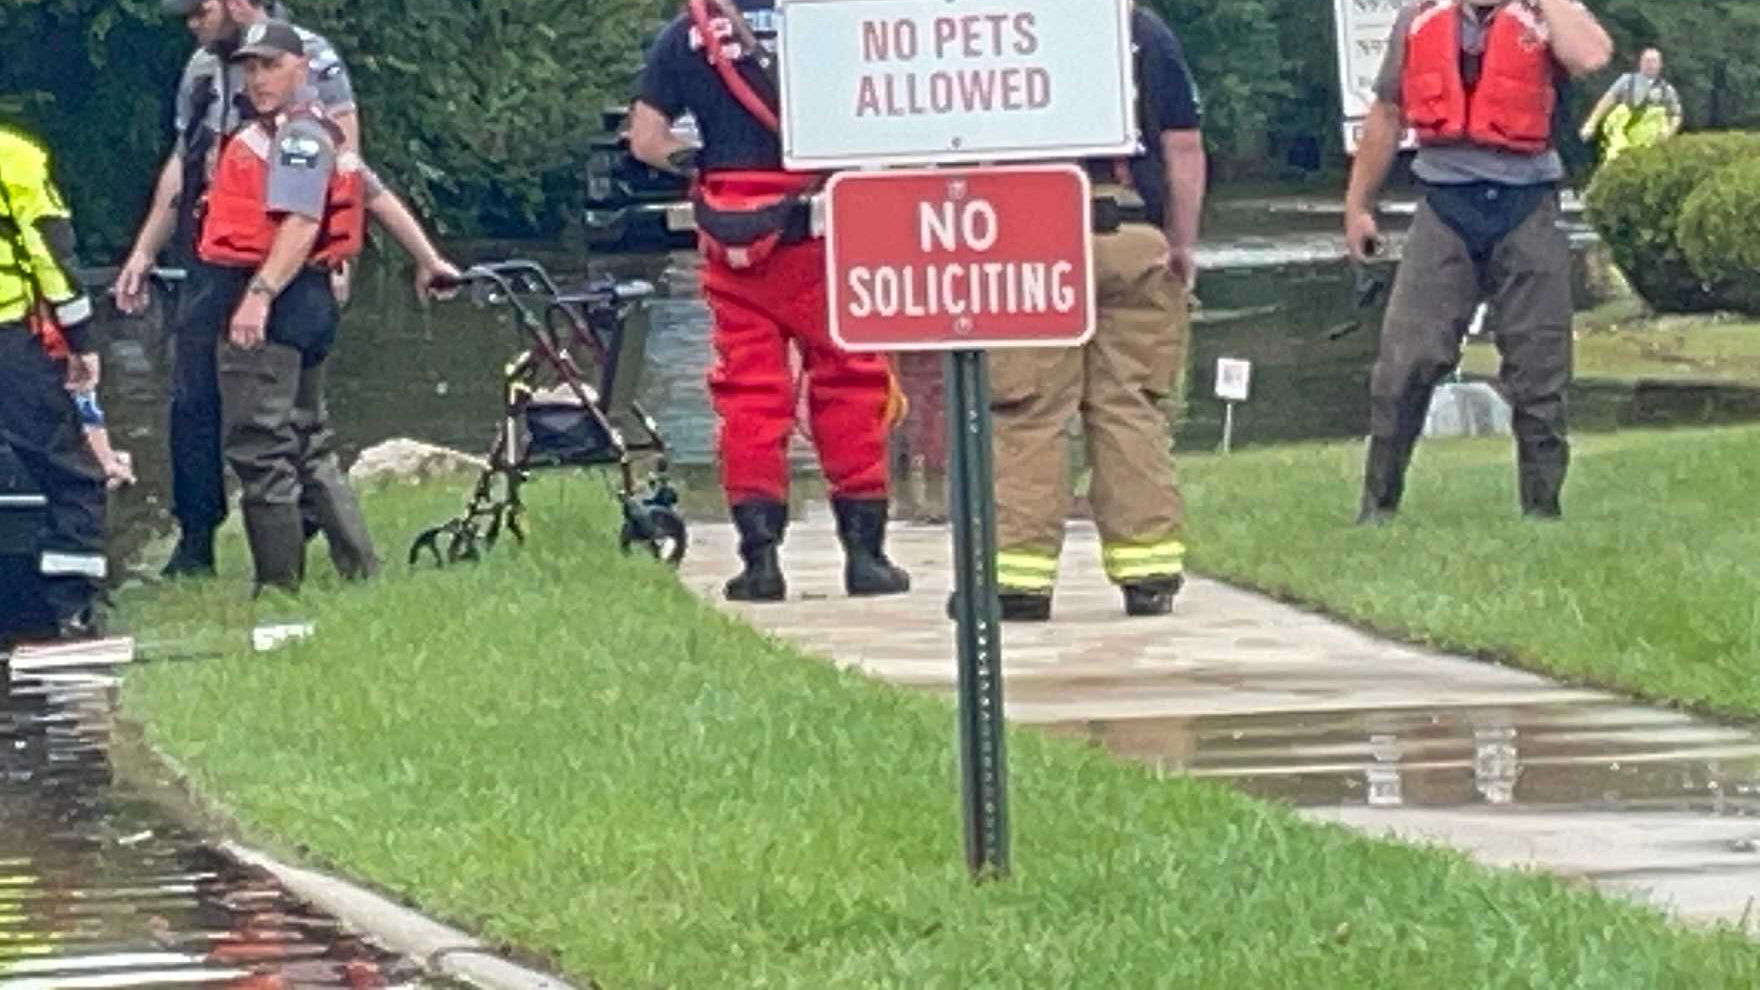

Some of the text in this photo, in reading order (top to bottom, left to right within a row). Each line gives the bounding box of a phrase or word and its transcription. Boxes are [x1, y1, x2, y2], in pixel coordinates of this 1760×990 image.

[863, 11, 1038, 63] NO PETS
[856, 66, 1051, 117] ALLOWED
[919, 199, 998, 252] NO
[848, 259, 1075, 317] SOLICITING
